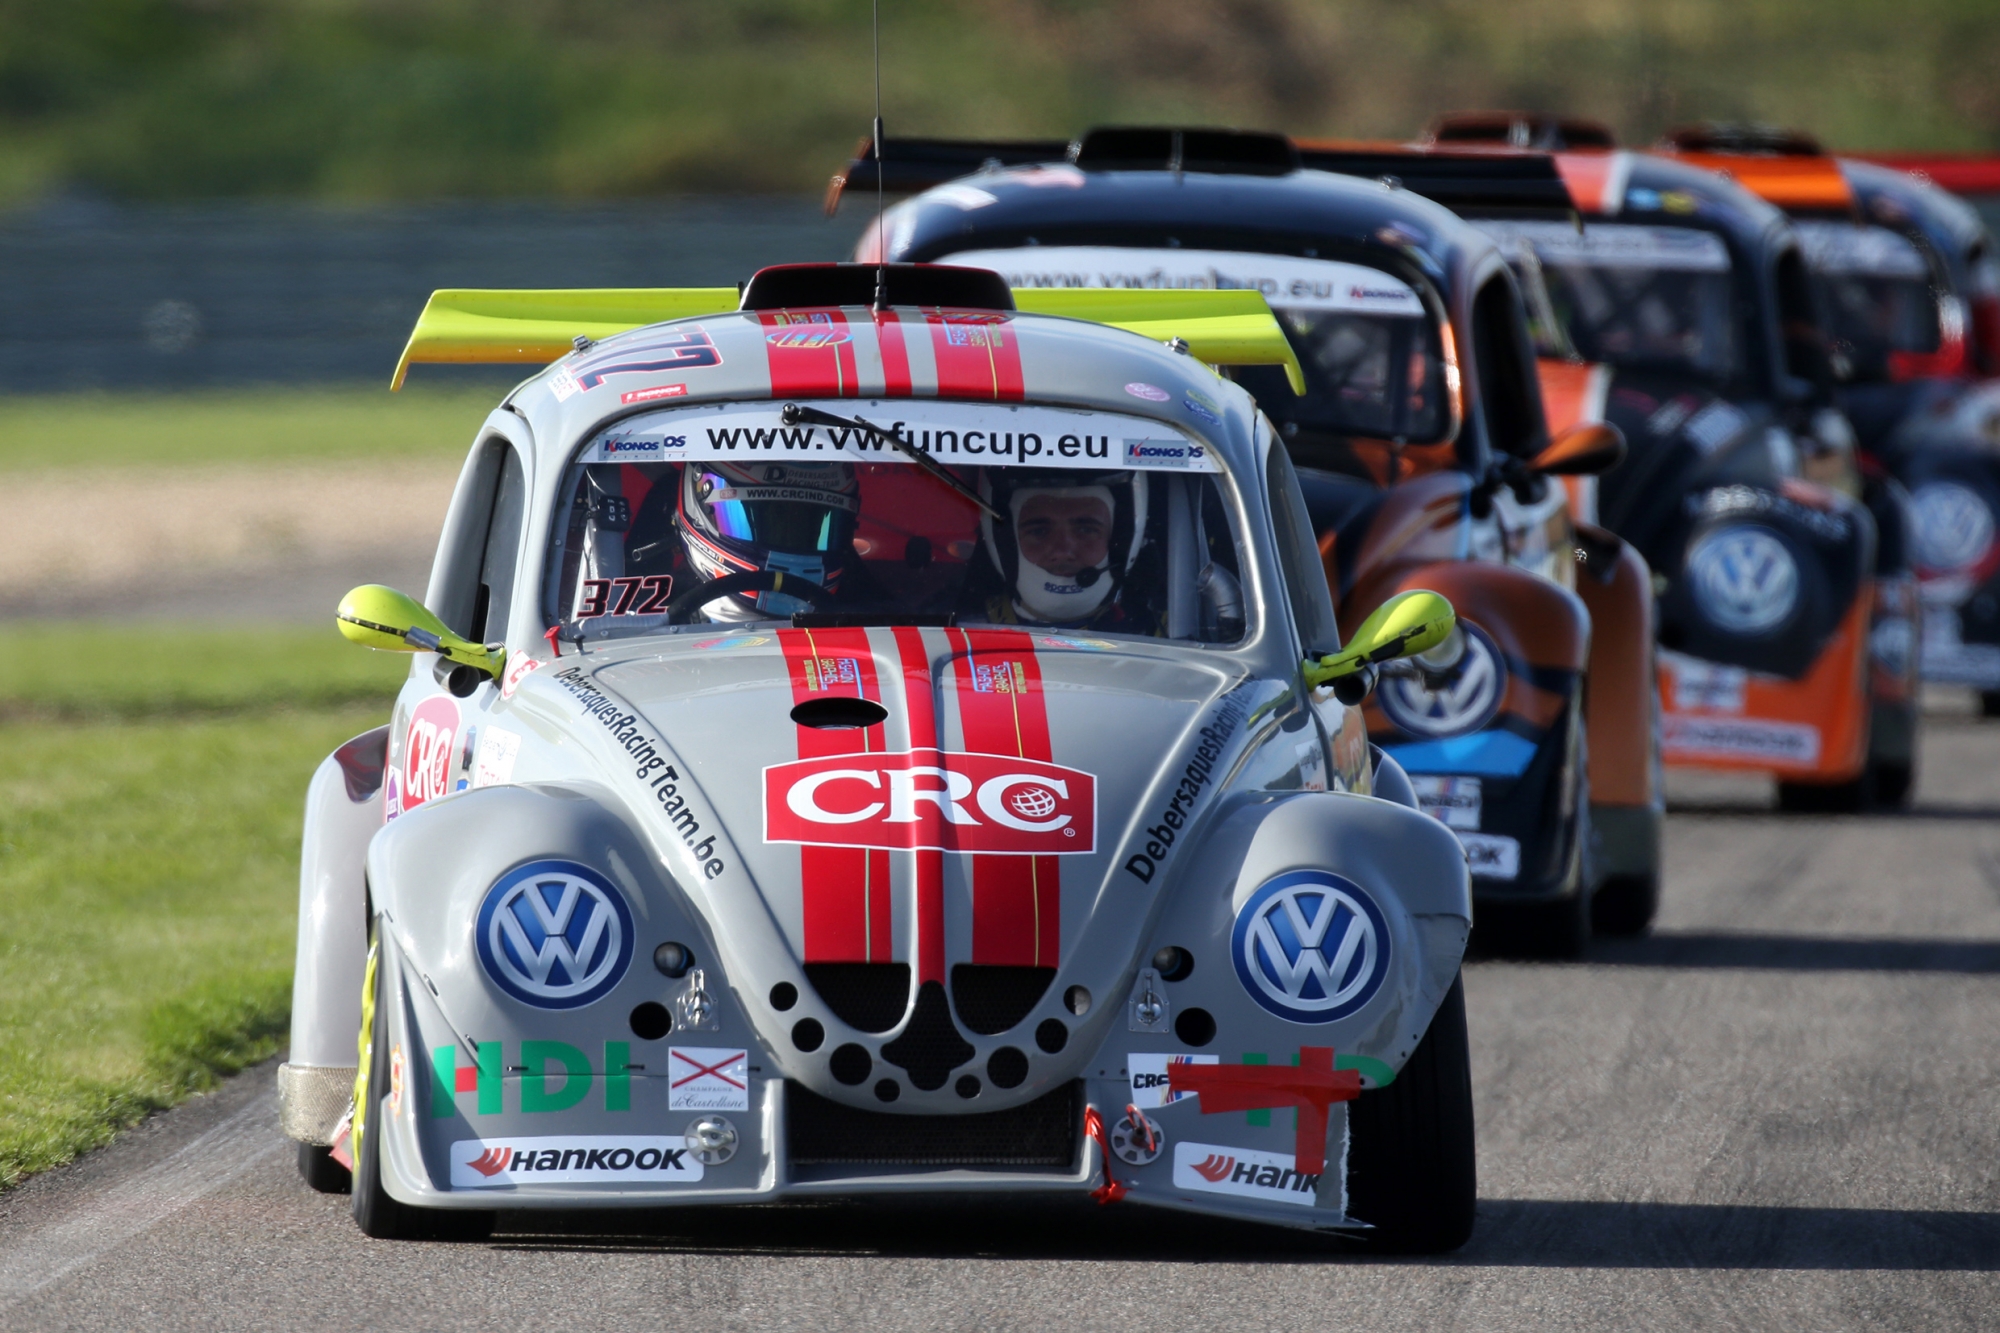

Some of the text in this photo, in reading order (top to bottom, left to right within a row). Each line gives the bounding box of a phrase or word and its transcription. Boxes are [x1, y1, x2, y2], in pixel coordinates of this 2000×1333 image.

[603, 435, 660, 453] KRONOS
[706, 421, 1109, 463] www.vwfuncup.eu
[1128, 440, 1185, 458] KRONOS
[746, 488, 846, 505] WWW.CRCIND.COM
[576, 575, 674, 619] 372
[405, 717, 453, 801] CRC
[554, 666, 725, 881] DebersaquesRacingTeam.be
[786, 767, 1073, 832] CRC
[432, 1040, 631, 1118] HDI
